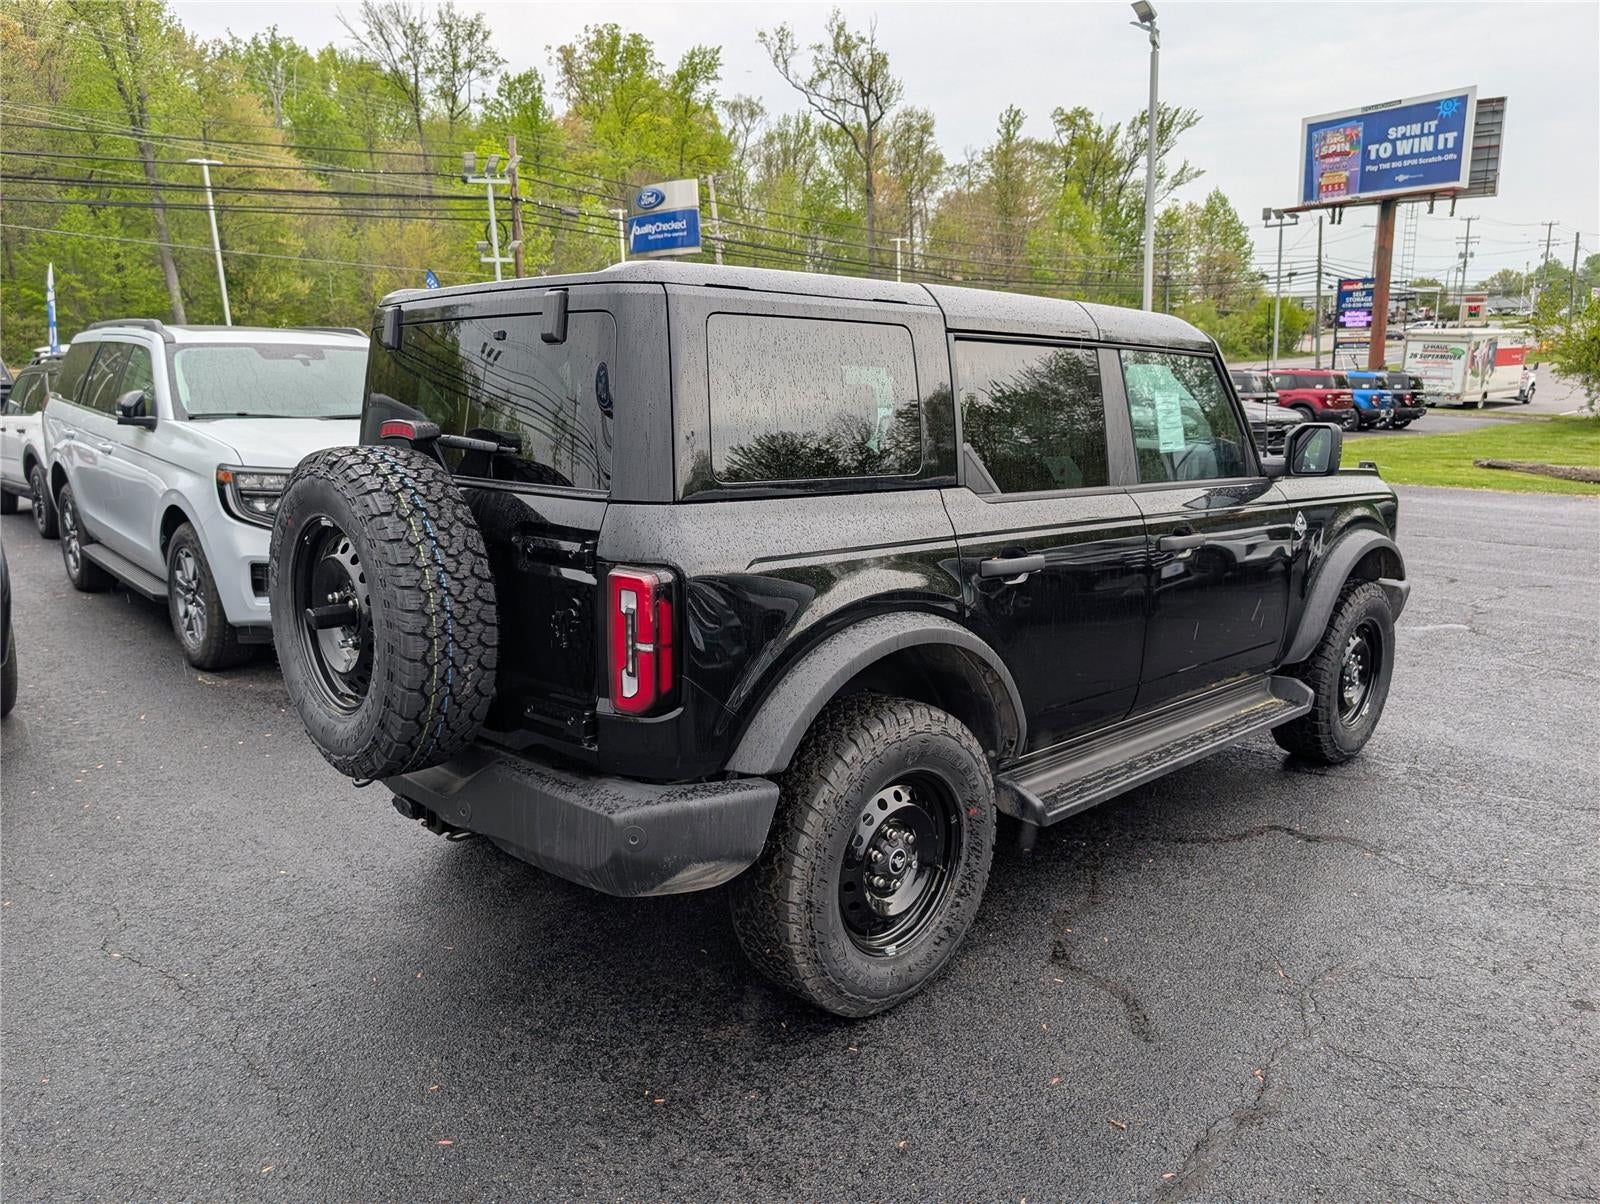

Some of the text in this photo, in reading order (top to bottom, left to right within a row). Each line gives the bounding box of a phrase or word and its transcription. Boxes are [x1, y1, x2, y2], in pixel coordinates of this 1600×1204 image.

[1387, 119, 1439, 140] SPIN IT
[1320, 143, 1350, 156] SPIN
[1367, 131, 1459, 161] TO WIN IT
[1379, 162, 1391, 170] THE
[1391, 160, 1403, 169] BIG
[1403, 158, 1418, 168] SPIN
[640, 192, 656, 205] Ford
[1419, 353, 1462, 361] SUPERMOVER
